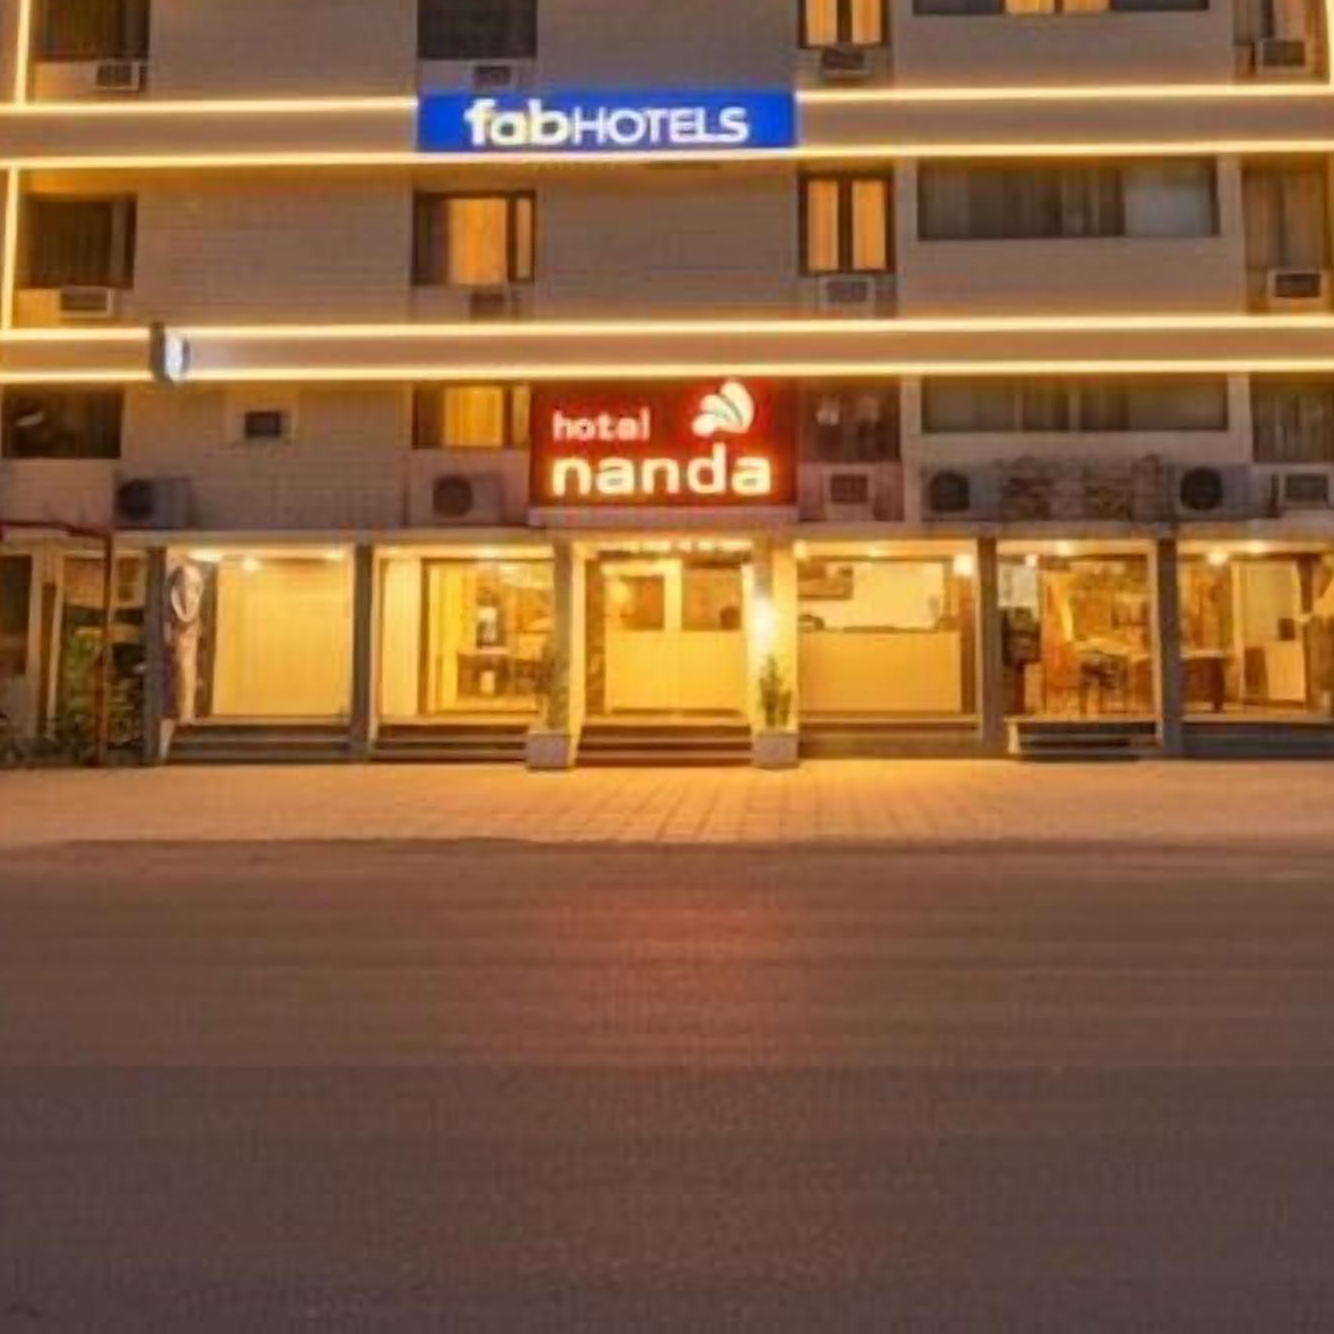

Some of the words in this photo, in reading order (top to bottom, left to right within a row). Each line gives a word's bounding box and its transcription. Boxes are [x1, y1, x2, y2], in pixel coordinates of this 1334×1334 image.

[464, 98, 749, 145] fabHOTELS
[553, 409, 650, 441] hotel
[550, 442, 773, 497] nanda
